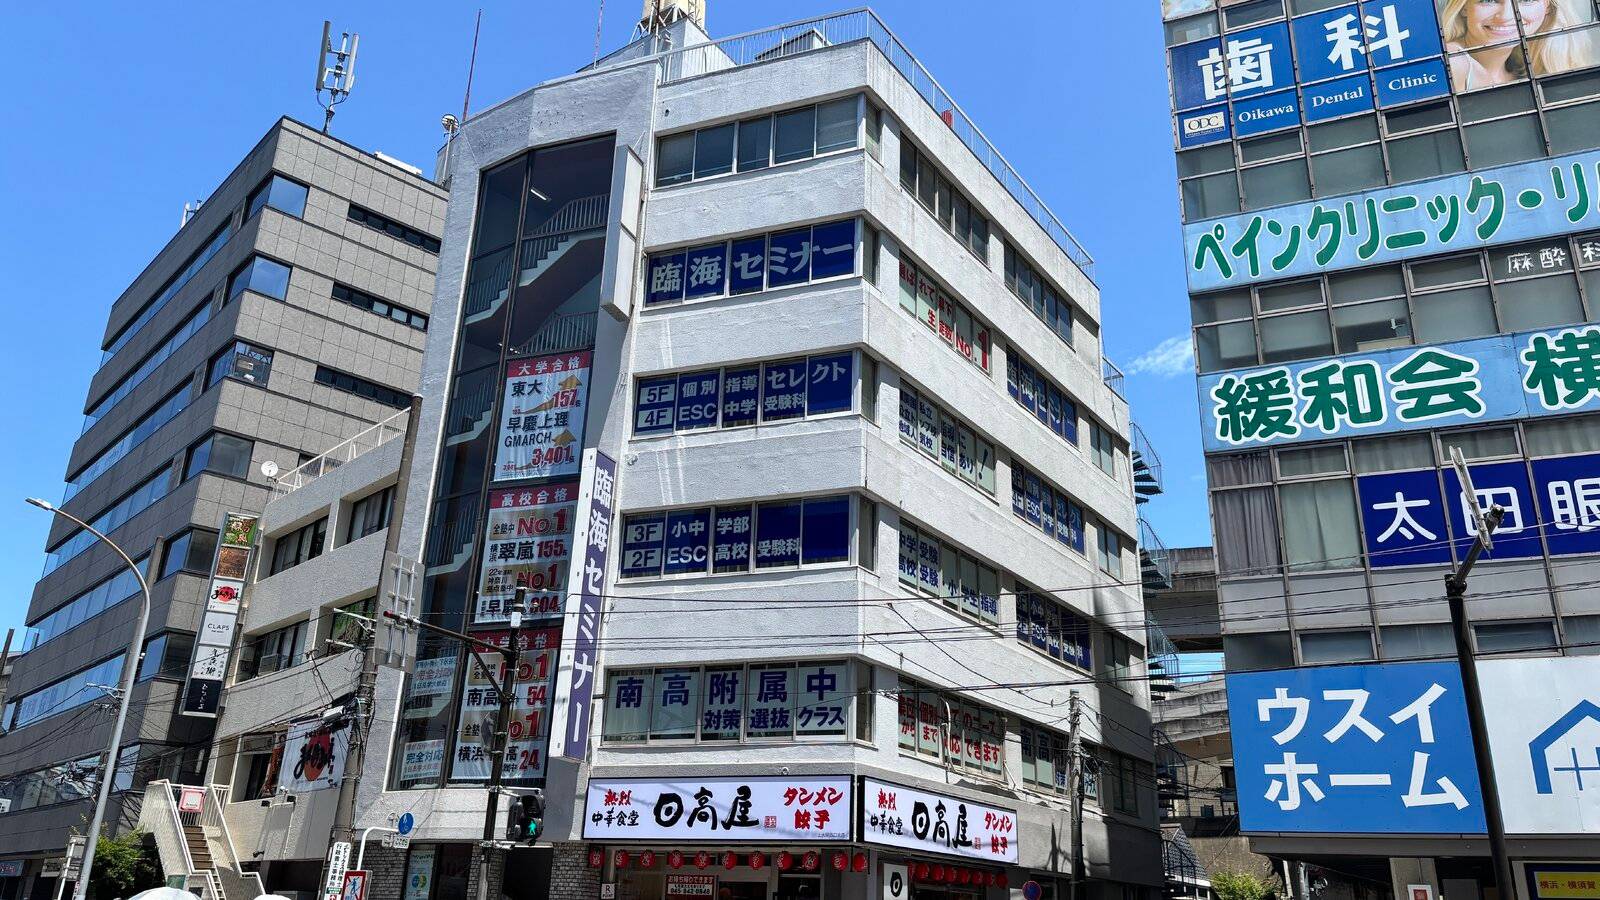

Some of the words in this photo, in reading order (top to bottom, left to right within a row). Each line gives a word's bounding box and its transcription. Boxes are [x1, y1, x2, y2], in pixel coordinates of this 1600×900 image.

[1197, 4, 1410, 101] 歯科
[1238, 104, 1295, 122] Oikawa
[1311, 86, 1364, 108] Dental
[1388, 71, 1438, 92] Clinic
[1188, 115, 1219, 130] ODC
[1193, 162, 1600, 280] ペインクリニック・リ
[651, 241, 853, 293] 臨海セミナー
[518, 355, 580, 376] 大学合格
[511, 379, 543, 397] 東大
[682, 361, 847, 398] 個別指導セレクト
[647, 386, 670, 403] 5F
[678, 403, 717, 422] ESC
[724, 391, 806, 417] 中学受験科
[1212, 348, 1485, 443] 緩和会
[507, 411, 569, 433] 早慶上理
[645, 410, 667, 427] 4F
[504, 431, 552, 448] GMARCH
[502, 487, 568, 508] 高校合格
[634, 525, 657, 542] 3F
[671, 516, 750, 538] 小中学部
[498, 540, 536, 562] 翠嵐
[631, 550, 655, 567] 2F
[667, 545, 708, 565] ESC
[715, 537, 801, 561] 高校受験科
[573, 466, 614, 743] 臨海セミナー
[615, 667, 837, 709] 南高附属中
[703, 706, 845, 731] 対策選抜クラス
[1257, 683, 1448, 746] ウスイ
[405, 750, 444, 765] 完全対応
[1264, 752, 1471, 811] ホーム
[591, 806, 640, 829] 中華食堂
[794, 808, 830, 830] 餃子
[604, 789, 632, 807] 熱烈
[653, 785, 760, 831] 日高屋
[783, 786, 844, 807] タンメン
[878, 788, 897, 811] 熱烈
[911, 799, 973, 849] 日高屋
[984, 811, 1013, 833] タンメン
[870, 810, 904, 836] 中華食堂
[990, 833, 1008, 856] 餃子
